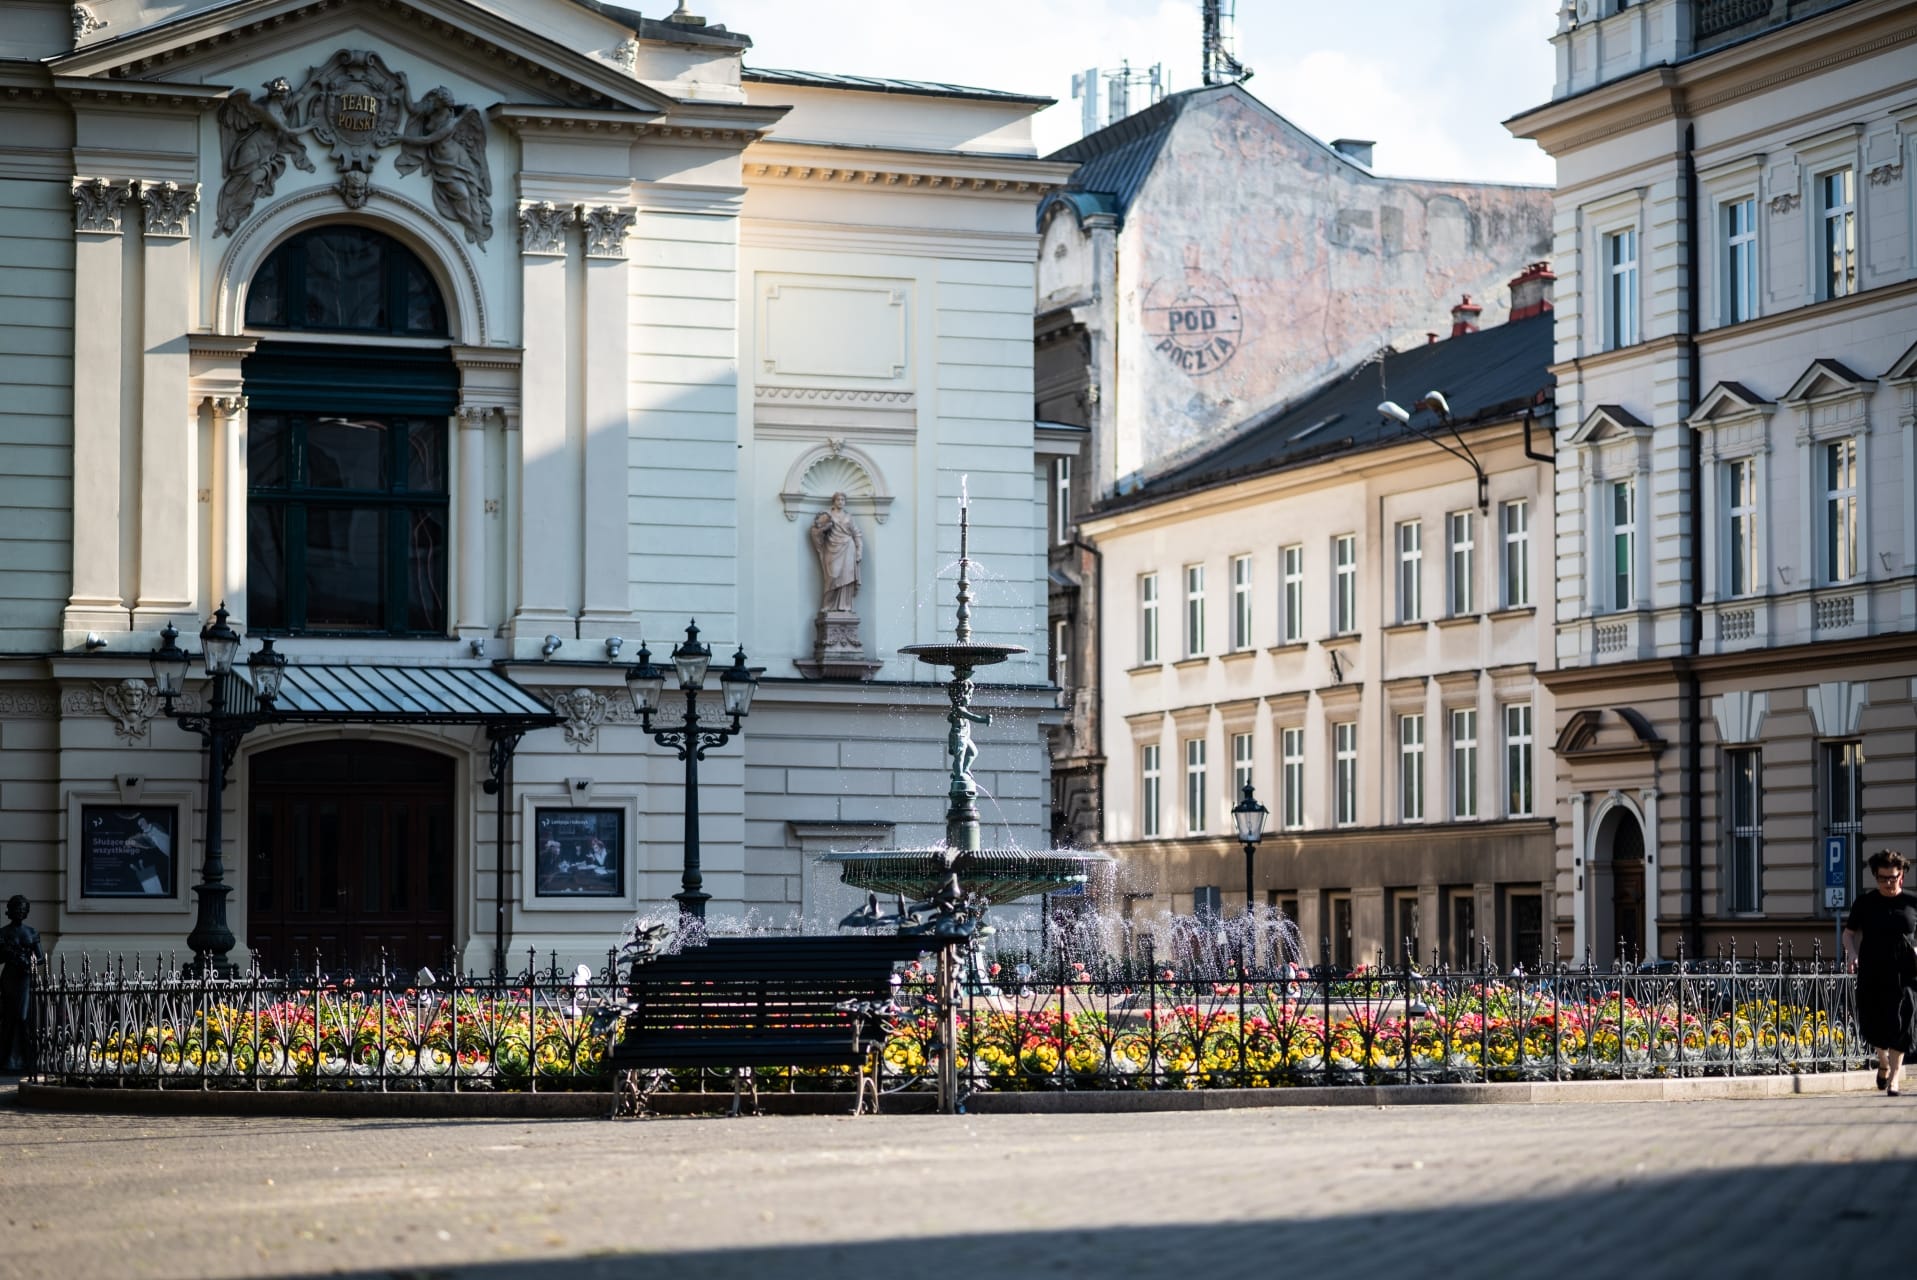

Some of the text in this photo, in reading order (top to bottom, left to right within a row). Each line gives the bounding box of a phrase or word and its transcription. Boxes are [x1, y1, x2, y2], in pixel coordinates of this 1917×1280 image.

[340, 94, 376, 114] TEATR
[338, 113, 375, 130] POLSKI
[1168, 309, 1216, 332] POD
[1155, 336, 1232, 370] POCZTA
[1829, 841, 1841, 873] P
